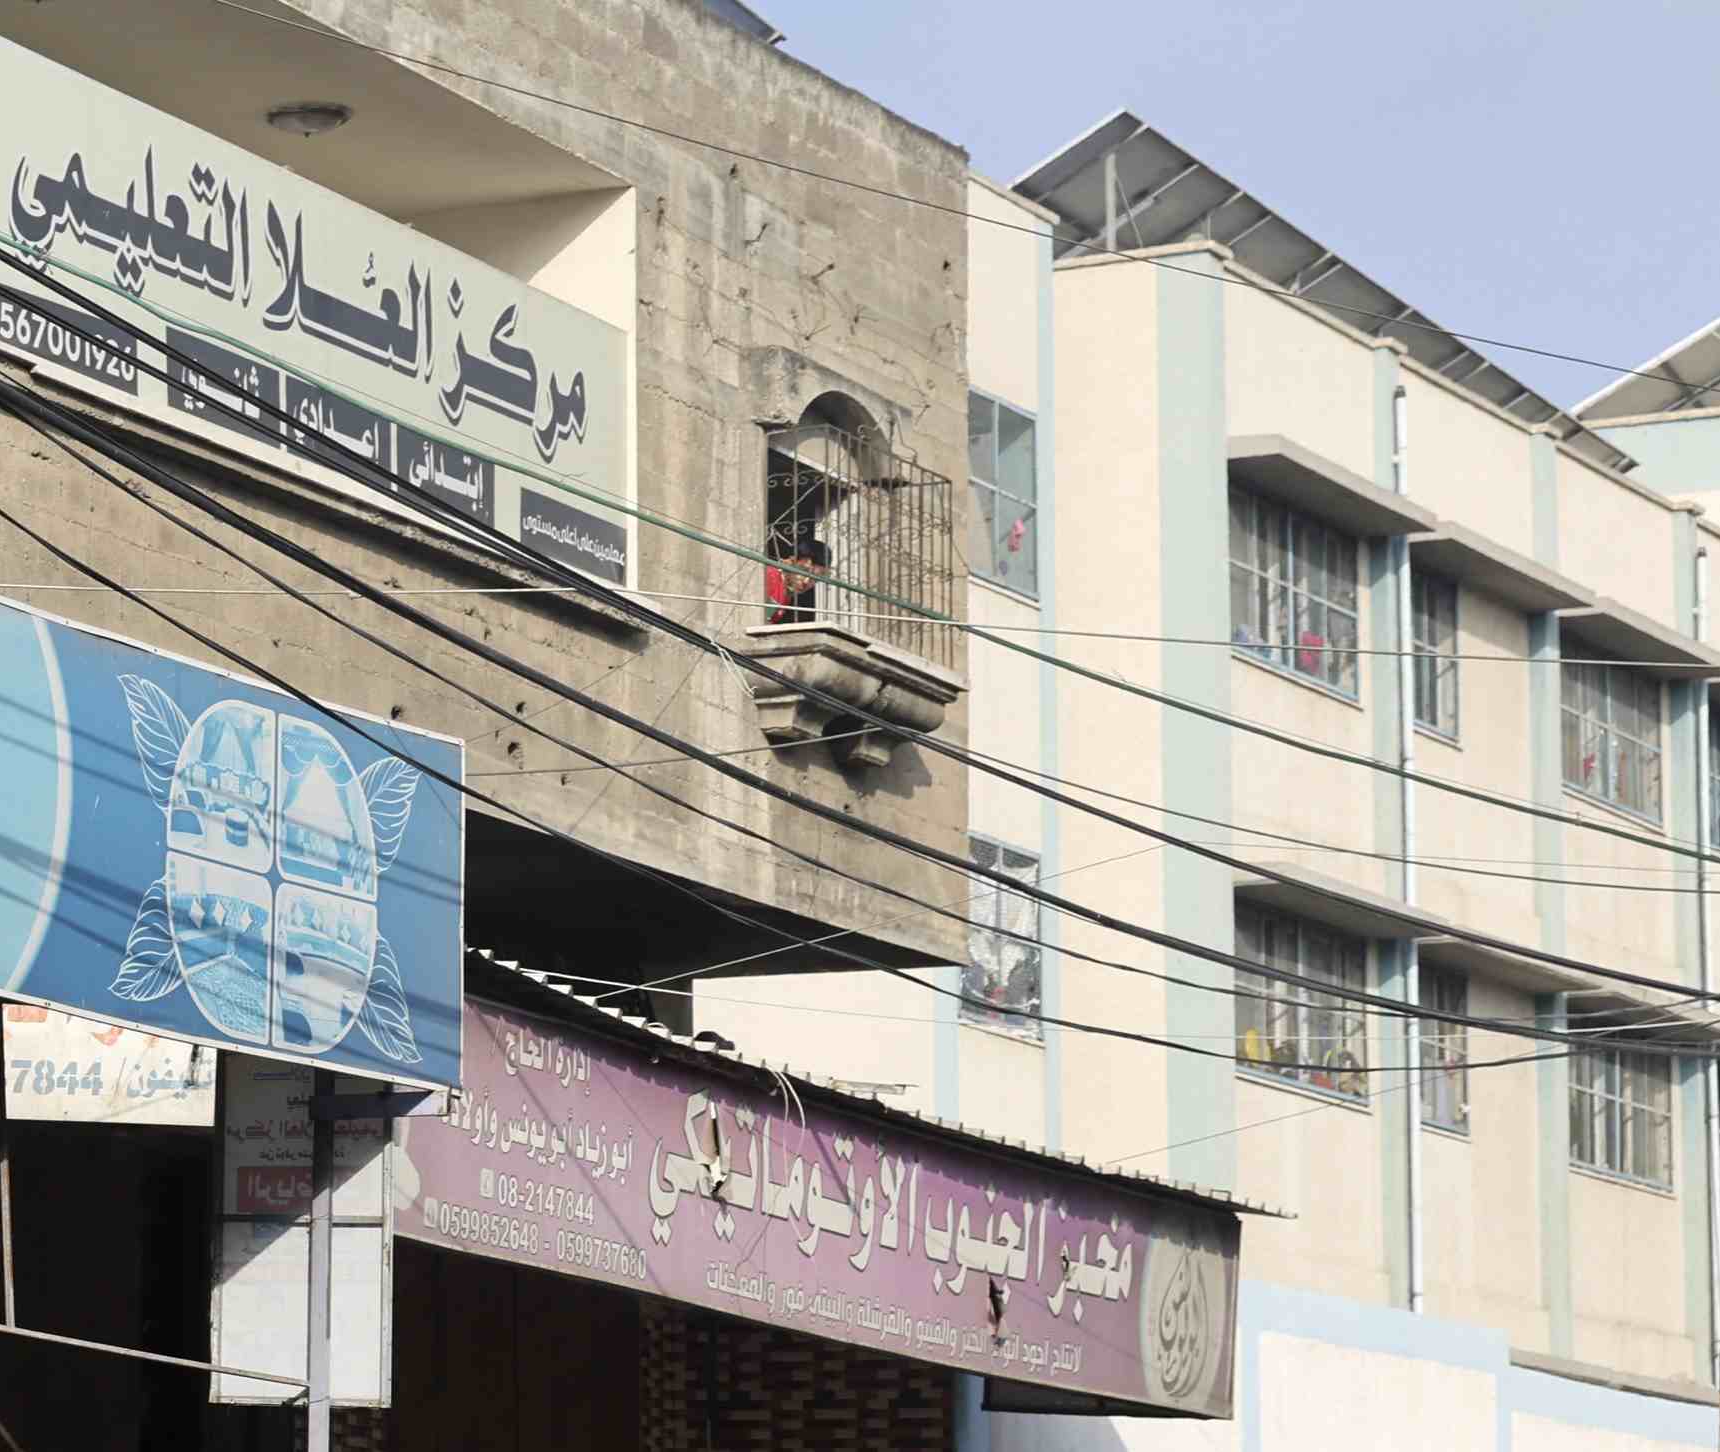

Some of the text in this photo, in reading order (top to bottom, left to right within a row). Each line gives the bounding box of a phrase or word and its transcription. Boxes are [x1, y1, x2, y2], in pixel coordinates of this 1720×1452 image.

[439, 270, 588, 462] مركز
[438, 1202, 540, 1255] 0599852648
[556, 1228, 647, 1280] 0599737680
[497, 1173, 595, 1225] 08-2147844
[924, 1183, 1048, 1306] الجنوب
[1046, 1205, 1133, 1325] مخبز
